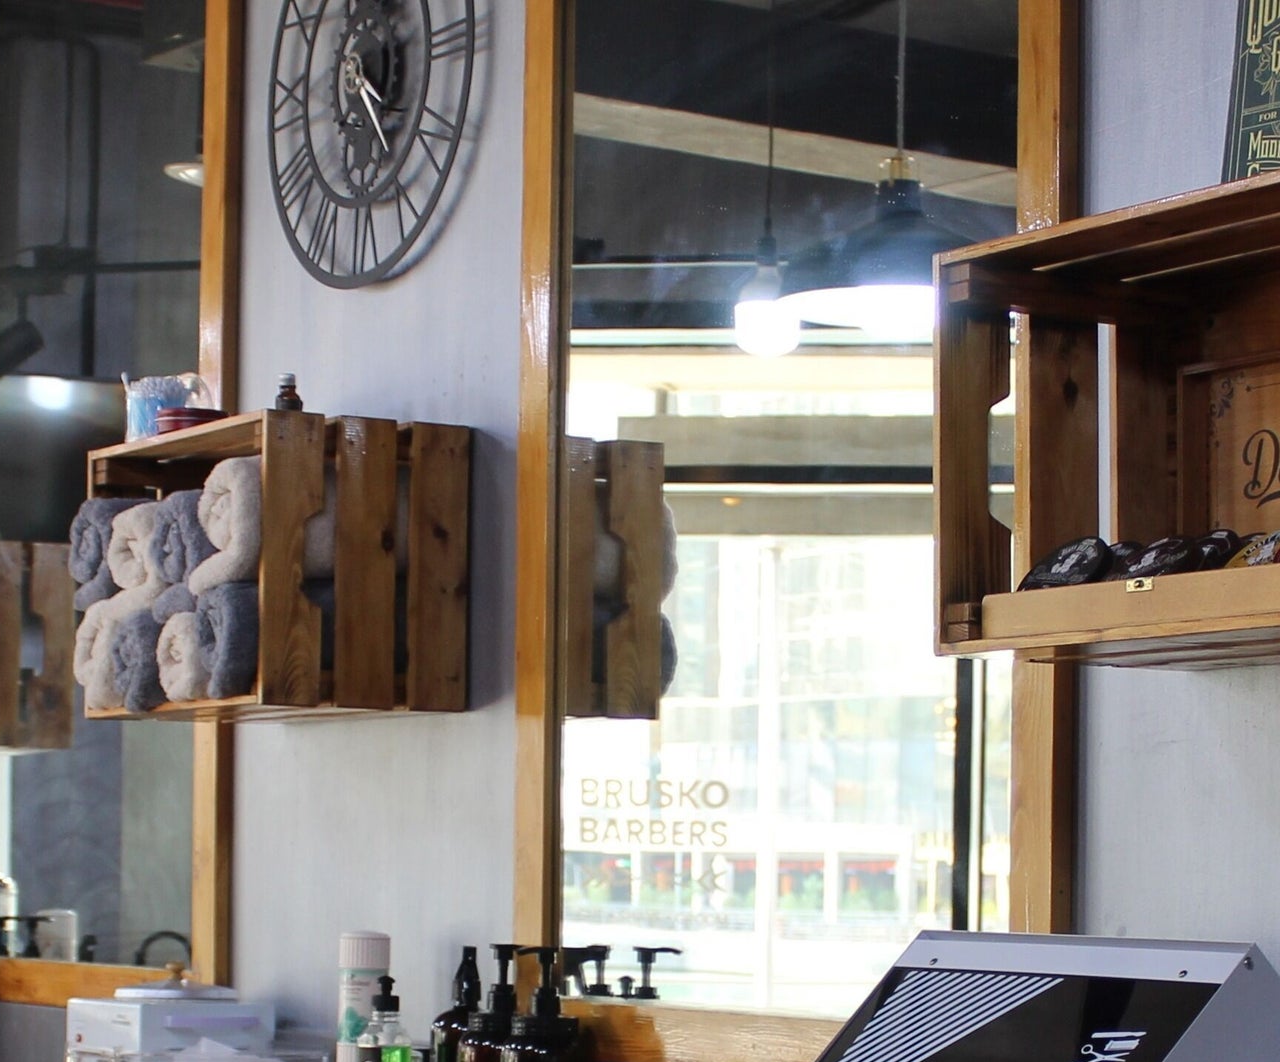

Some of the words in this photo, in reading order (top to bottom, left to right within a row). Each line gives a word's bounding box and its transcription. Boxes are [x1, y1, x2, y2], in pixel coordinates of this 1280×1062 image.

[1258, 110, 1277, 123] FOR
[580, 778, 730, 809] BRUSKO
[579, 816, 729, 847] BARBERS
